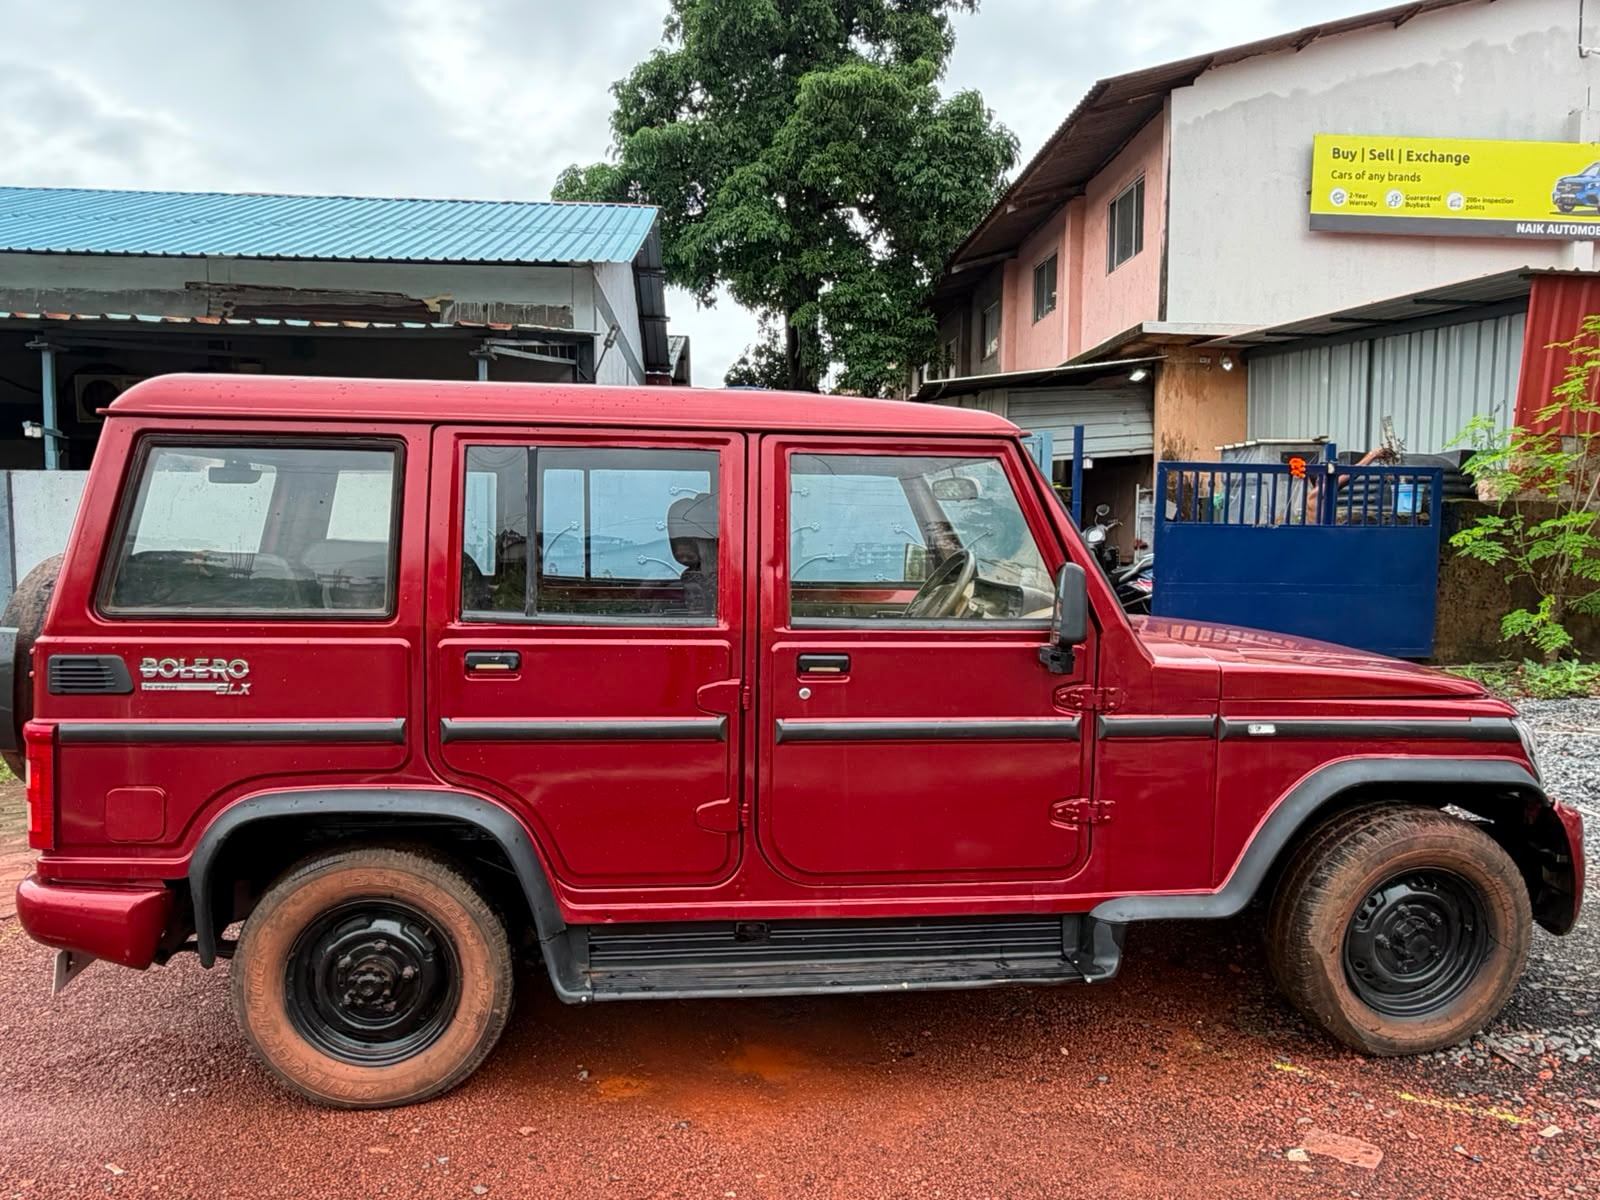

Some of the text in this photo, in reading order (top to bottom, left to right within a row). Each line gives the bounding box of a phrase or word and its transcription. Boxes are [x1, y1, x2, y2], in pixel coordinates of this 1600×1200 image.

[1332, 147, 1357, 163] Buy
[1369, 148, 1394, 161] Sell
[1406, 150, 1470, 166] Exchange
[1331, 170, 1421, 183] Cars of any brands
[1405, 194, 1441, 202] Guaranteed
[1517, 223, 1544, 234] NAIK
[140, 658, 249, 682] BOLERO
